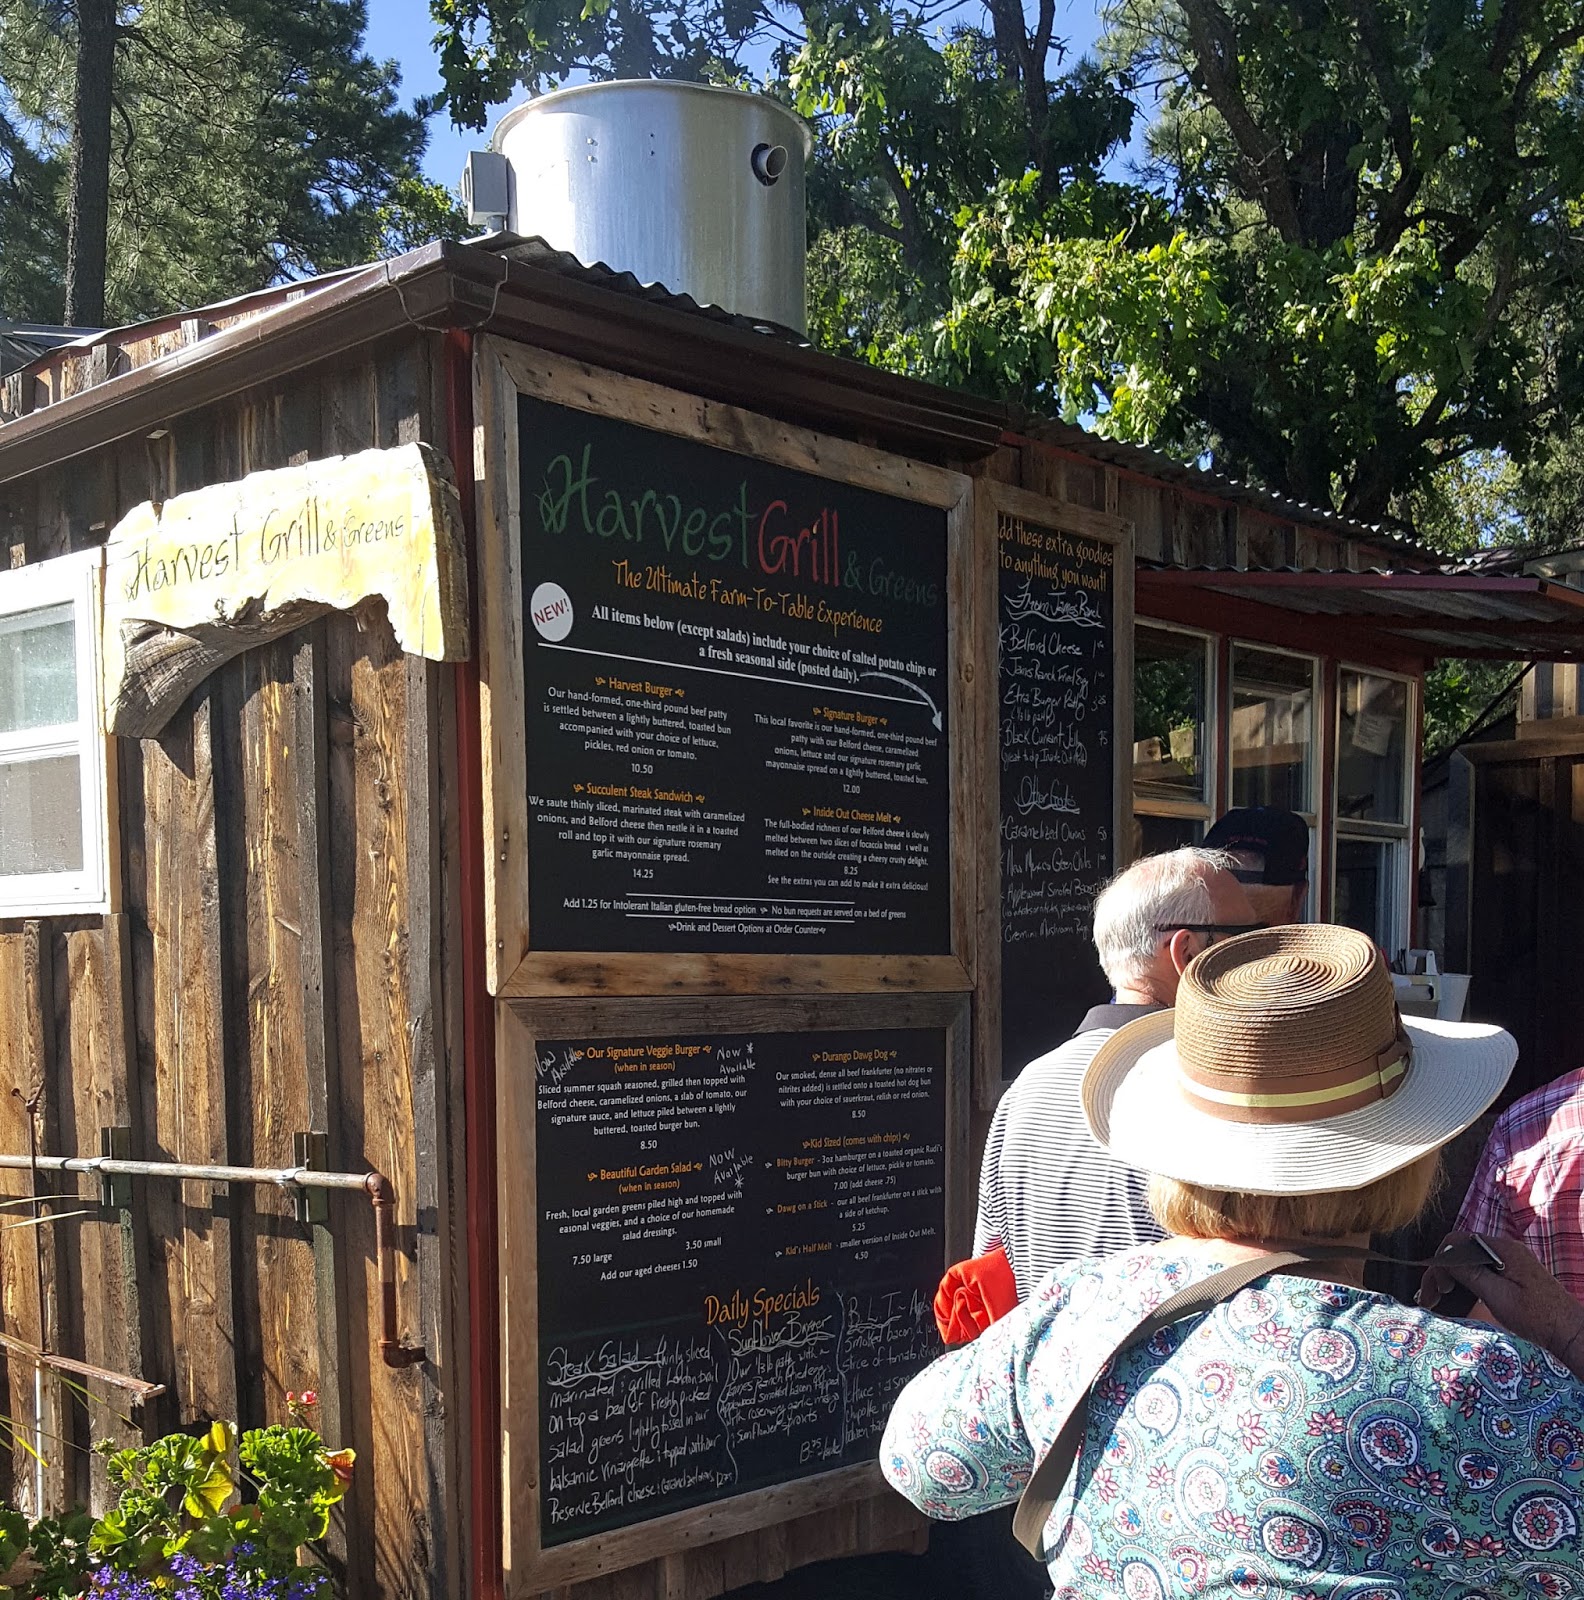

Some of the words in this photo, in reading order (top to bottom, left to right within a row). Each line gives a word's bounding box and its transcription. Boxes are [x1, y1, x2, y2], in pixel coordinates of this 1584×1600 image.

[539, 443, 757, 568] Harvest
[758, 500, 840, 587] Grill
[844, 551, 861, 589] &
[869, 556, 939, 608] Greens
[126, 511, 244, 601] Harvest
[261, 496, 319, 565] Grill
[324, 520, 338, 551] &
[343, 509, 404, 546] Greens
[998, 515, 1014, 540] dd
[1015, 520, 1043, 548] these
[1046, 531, 1074, 557] extra
[1076, 541, 1113, 568] goodies
[999, 544, 1012, 568] to
[1014, 553, 1060, 590] anything
[1062, 570, 1080, 589] you
[611, 560, 642, 588] The
[645, 566, 707, 599] Ultimate
[709, 580, 814, 619] Farm-To-Table
[816, 602, 882, 636] Experience
[534, 598, 570, 626] NEW!
[591, 606, 609, 620] All
[611, 610, 641, 625] items
[643, 614, 674, 631] below
[676, 620, 714, 640] (except
[716, 628, 750, 647] salads)
[752, 635, 787, 650] include
[788, 642, 810, 655] your
[812, 643, 840, 659] choice
[841, 649, 851, 661] of
[852, 651, 877, 666] salted
[878, 658, 904, 670] potato
[905, 660, 926, 677] chips
[927, 667, 936, 676] or
[698, 646, 705, 657] a
[707, 645, 733, 661] fresh
[735, 652, 775, 668] seasonal
[777, 658, 796, 671] side
[797, 660, 830, 677] (posted
[832, 665, 860, 683] daily).
[608, 676, 642, 692] Harvest
[644, 681, 673, 698] Burger
[547, 686, 566, 698] Our
[567, 689, 624, 706] hand-formed,
[625, 699, 662, 710] one-third
[663, 704, 688, 714] pound
[690, 705, 707, 716] beef
[708, 710, 727, 721] patty
[822, 706, 855, 721] Signature
[856, 711, 880, 726] Burger
[584, 739, 614, 751] pickles,
[615, 743, 629, 752] red
[630, 746, 654, 755] onion
[656, 748, 665, 756] or
[667, 749, 697, 760] tomato.
[631, 762, 653, 774] 10.50
[586, 782, 627, 797] Succulent
[629, 785, 652, 799] Steak
[654, 788, 693, 802] Sandwich
[842, 783, 860, 794] 12.00
[813, 805, 834, 818] Inside
[835, 807, 849, 819] Out
[850, 809, 875, 821] Cheese
[875, 811, 891, 823] Melt
[592, 847, 613, 859] garlic
[615, 850, 661, 860] mayonnaise
[662, 852, 689, 863] spread.
[632, 868, 653, 878] 14.25
[843, 865, 858, 875] 8.25
[562, 897, 580, 908] Add
[581, 898, 598, 908] 1.25
[599, 898, 611, 909] for
[613, 899, 649, 910] Intolerant
[650, 901, 673, 911] Italian
[674, 902, 711, 914] gluten-free
[712, 903, 732, 913] bread
[733, 904, 756, 915] option
[676, 921, 696, 931] Drink
[697, 922, 710, 932] and
[712, 922, 736, 932] Dessert
[737, 922, 764, 935] Options
[765, 924, 772, 933] at
[773, 923, 793, 933] Order
[794, 924, 820, 934] Counter
[586, 1046, 604, 1058] Our
[606, 1046, 644, 1060] Signature
[645, 1044, 673, 1058] Veggie
[674, 1043, 700, 1057] Burger
[822, 1051, 852, 1063] Durango
[852, 1049, 873, 1062] Dawg
[873, 1049, 888, 1061] Dog
[614, 1062, 638, 1073] (when
[639, 1062, 647, 1071] in
[649, 1060, 675, 1071] season)
[538, 1083, 561, 1094] Sliced
[563, 1084, 595, 1093] summer
[596, 1081, 622, 1093] squash
[624, 1079, 659, 1089] seasoned,
[661, 1077, 683, 1090] grilled
[685, 1077, 701, 1086] then
[702, 1075, 728, 1087] topped
[729, 1074, 745, 1083] with
[851, 1109, 866, 1118] 8.50
[640, 1139, 657, 1149] 8.50
[810, 1137, 822, 1148] Kid
[823, 1136, 841, 1147] Sized
[866, 1133, 881, 1143] with
[600, 1166, 637, 1180] Beautiful
[638, 1164, 669, 1176] Garden
[670, 1161, 691, 1173] Salad
[793, 1156, 814, 1167] Burger
[618, 1183, 642, 1195] (when
[644, 1181, 652, 1190] in
[653, 1178, 680, 1189] season)
[685, 1239, 702, 1250] 3.50
[703, 1236, 721, 1247] small
[572, 1254, 591, 1265] 7.50
[593, 1253, 612, 1263] large
[600, 1269, 617, 1280] Add
[618, 1269, 633, 1278] our
[634, 1264, 652, 1277] aged
[654, 1262, 680, 1273] cheeses
[682, 1258, 697, 1268] 1.50
[705, 1289, 749, 1329] Daily
[752, 1278, 820, 1330] Specials
